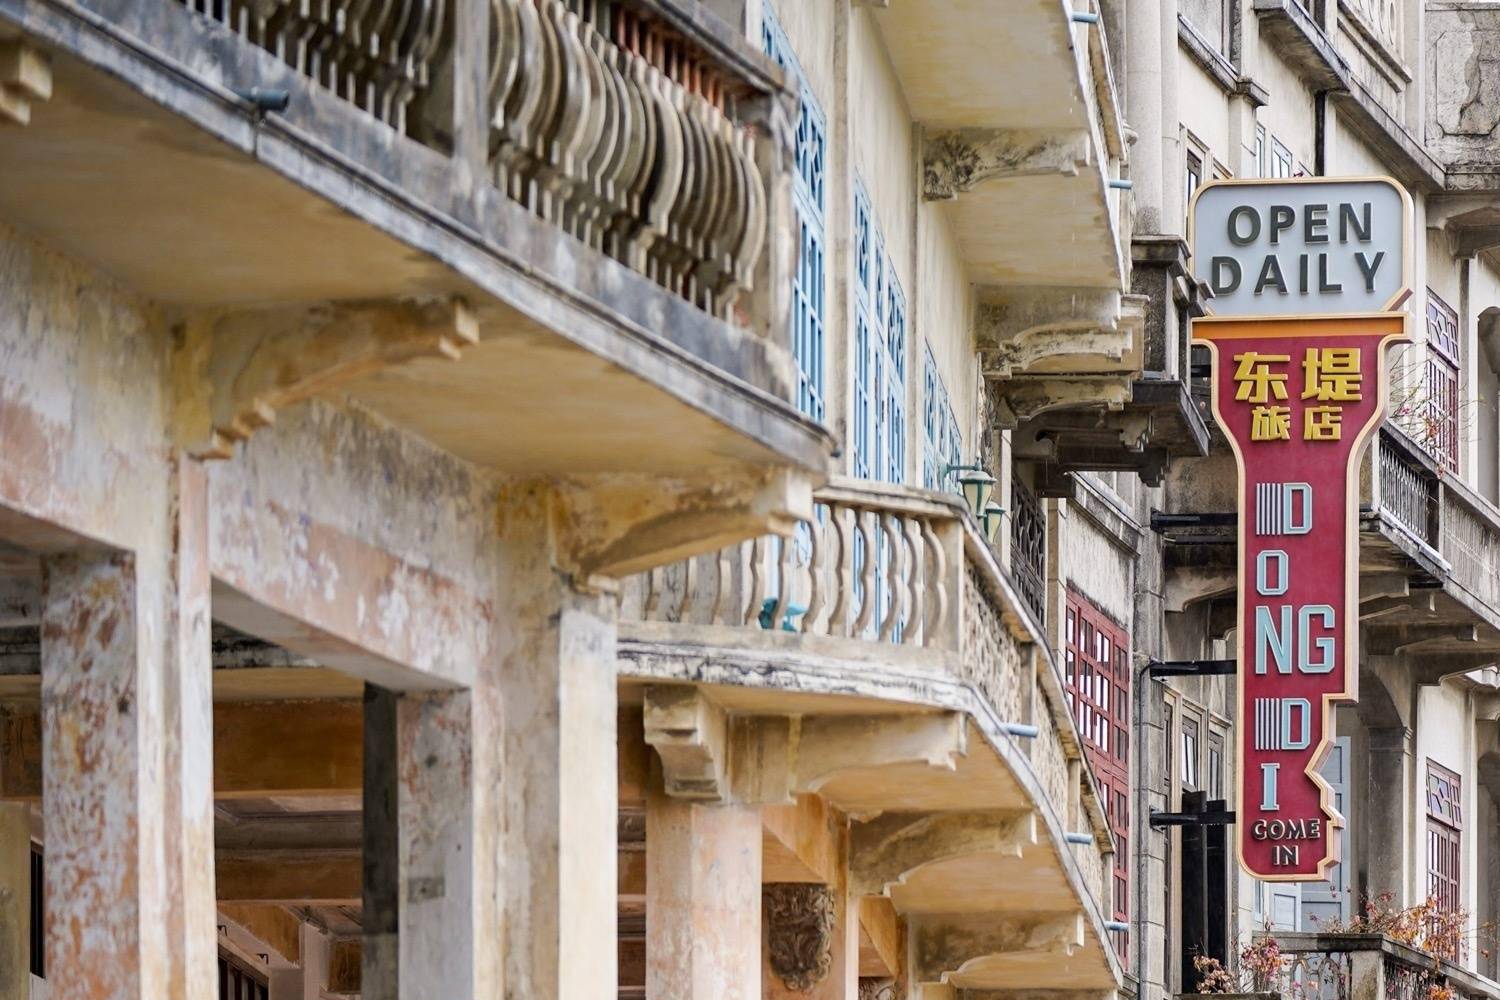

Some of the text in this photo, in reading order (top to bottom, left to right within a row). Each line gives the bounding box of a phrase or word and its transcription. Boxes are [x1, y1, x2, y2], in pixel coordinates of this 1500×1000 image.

[1227, 202, 1373, 246] OPEN
[1211, 250, 1386, 295] DAILY
[1234, 347, 1363, 403] 东堤
[1251, 405, 1343, 441] 旅店
[1251, 817, 1321, 841] COME
[1271, 844, 1300, 867] IN
